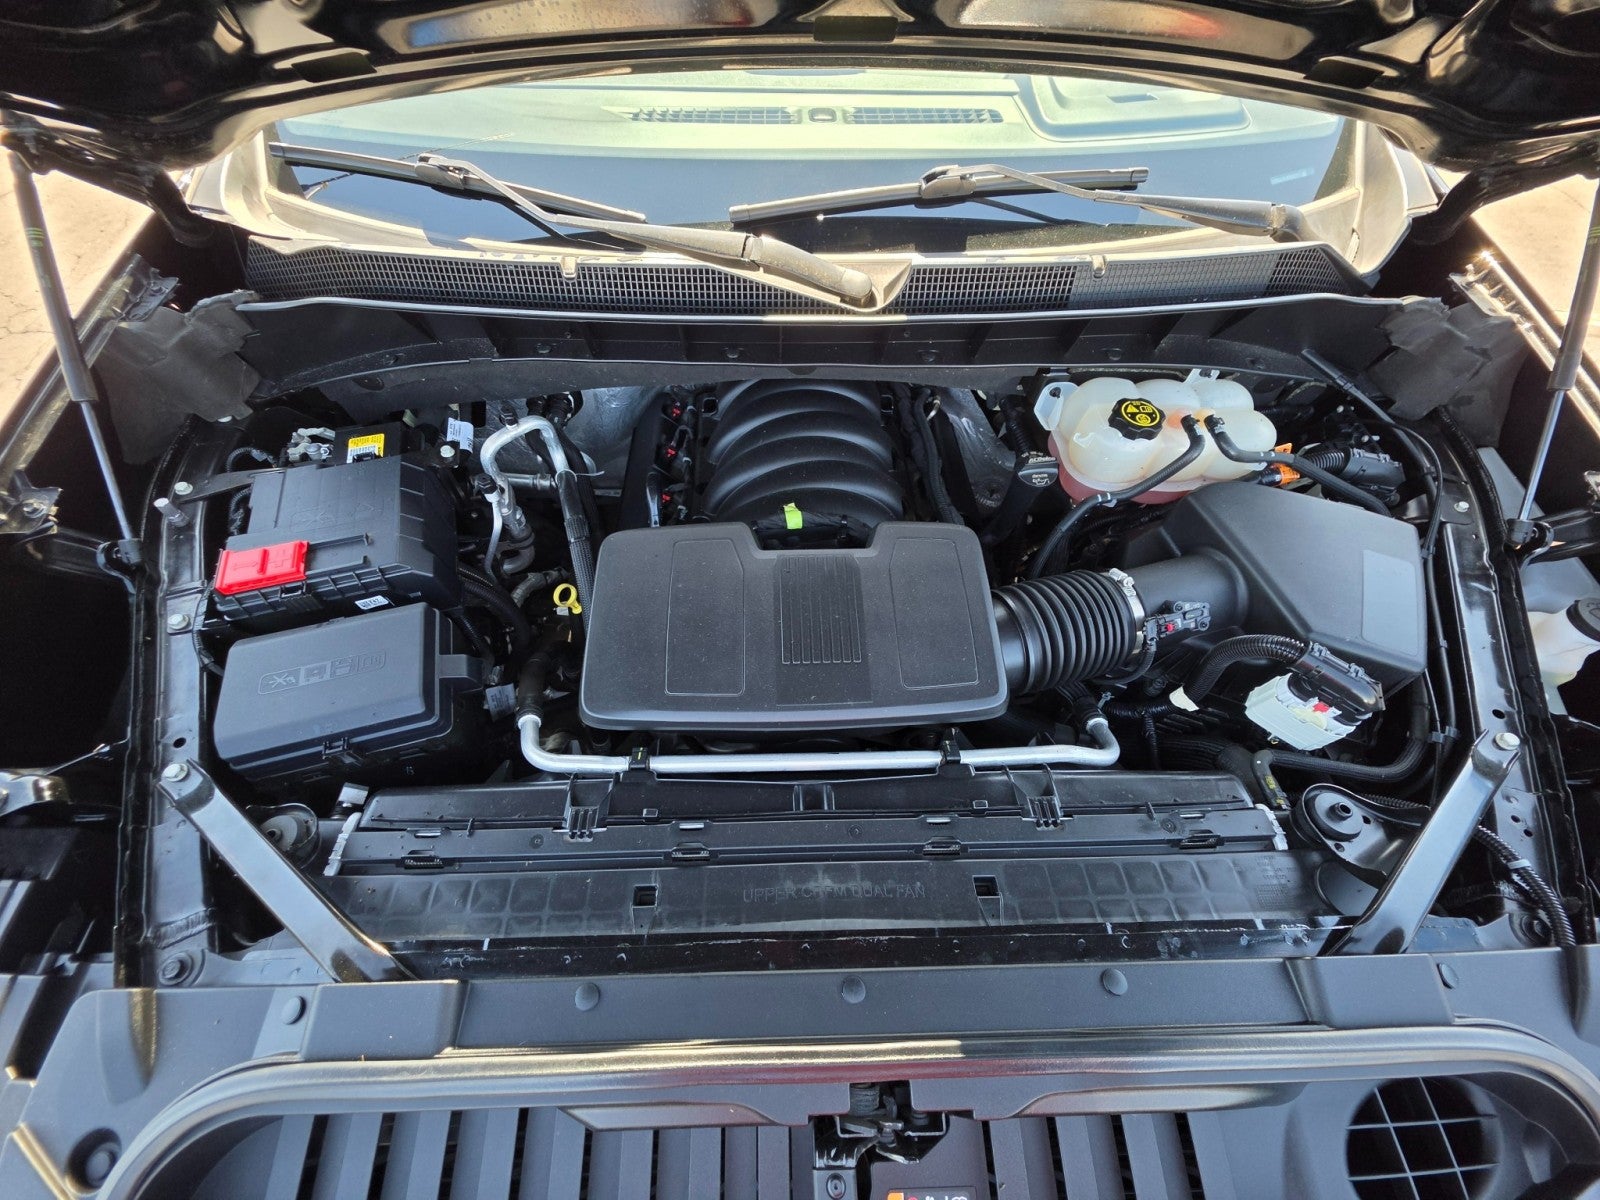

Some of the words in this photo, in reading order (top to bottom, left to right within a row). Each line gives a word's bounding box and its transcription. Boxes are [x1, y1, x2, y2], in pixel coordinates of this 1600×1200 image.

[743, 887, 797, 904] UPPER
[852, 883, 893, 898] DUAL
[895, 884, 926, 898] FAN
